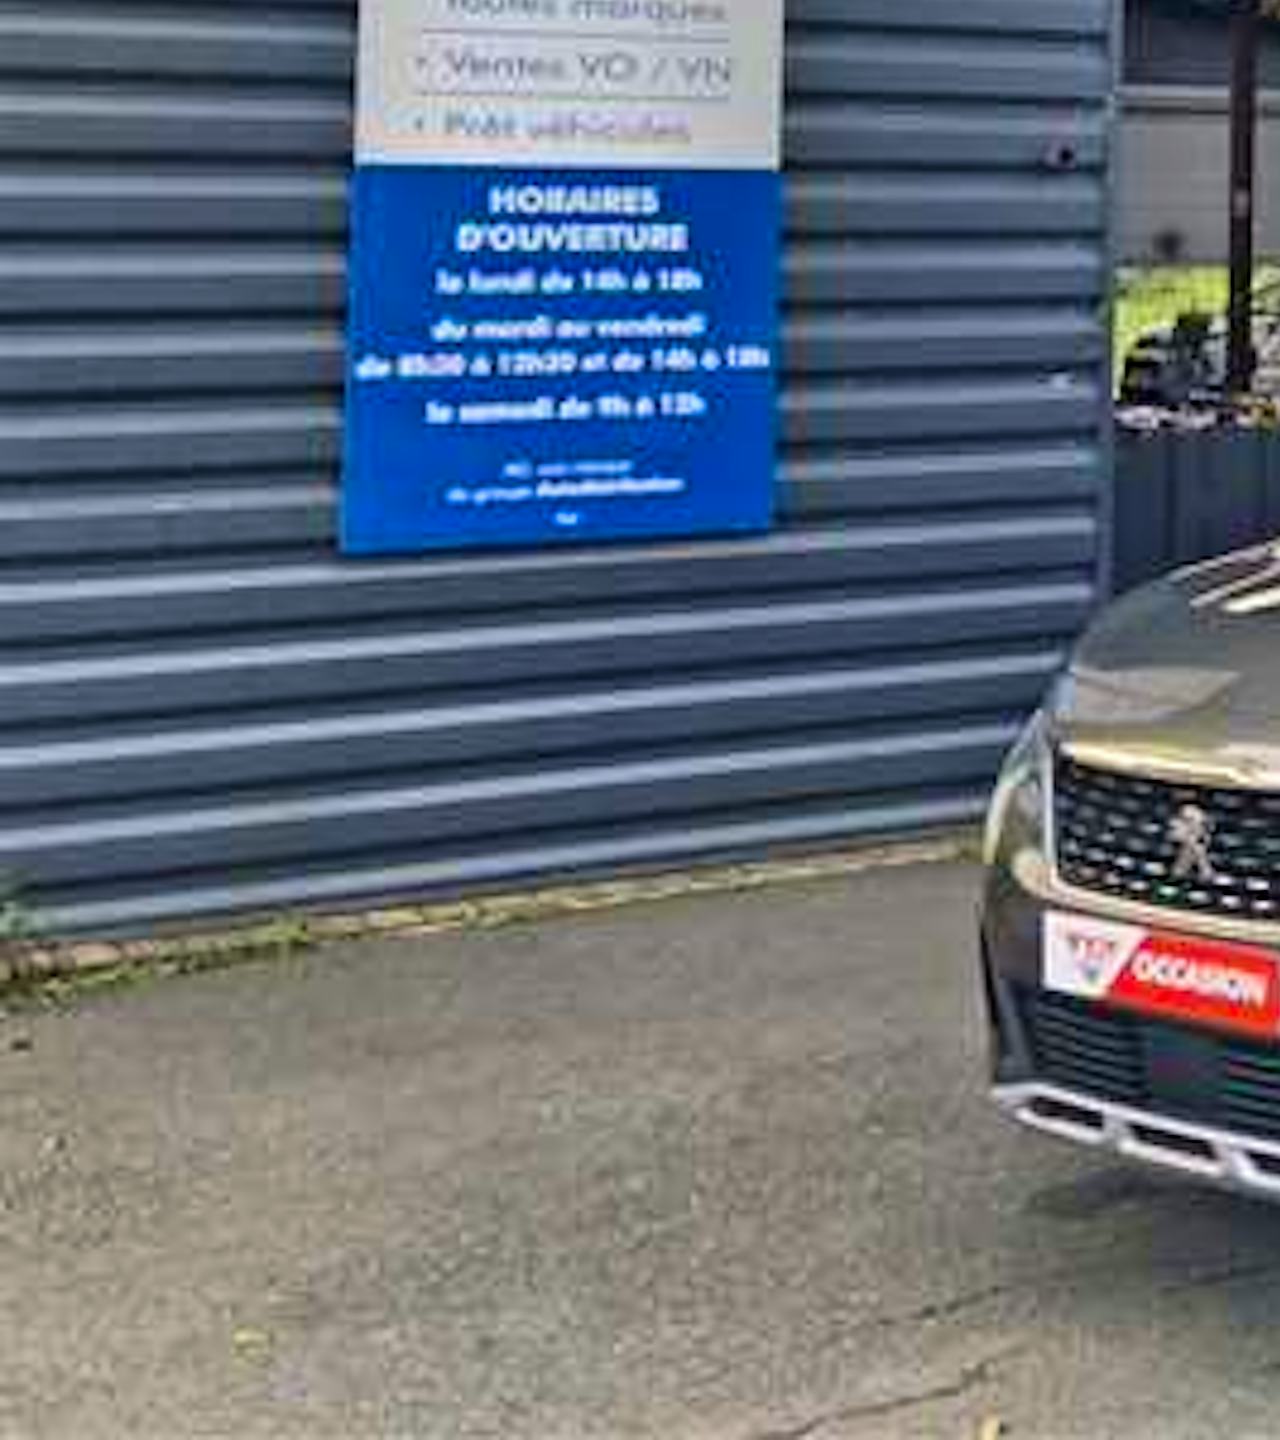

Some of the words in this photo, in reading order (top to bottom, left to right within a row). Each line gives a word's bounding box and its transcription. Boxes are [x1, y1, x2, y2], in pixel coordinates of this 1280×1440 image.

[448, 52, 566, 81] Ventes
[578, 51, 640, 82] VO
[488, 184, 660, 216] HORAIRES
[456, 221, 690, 254] D'OUVERTURE
[597, 312, 706, 339] vendredi
[1130, 950, 1270, 1009] OCCASION
